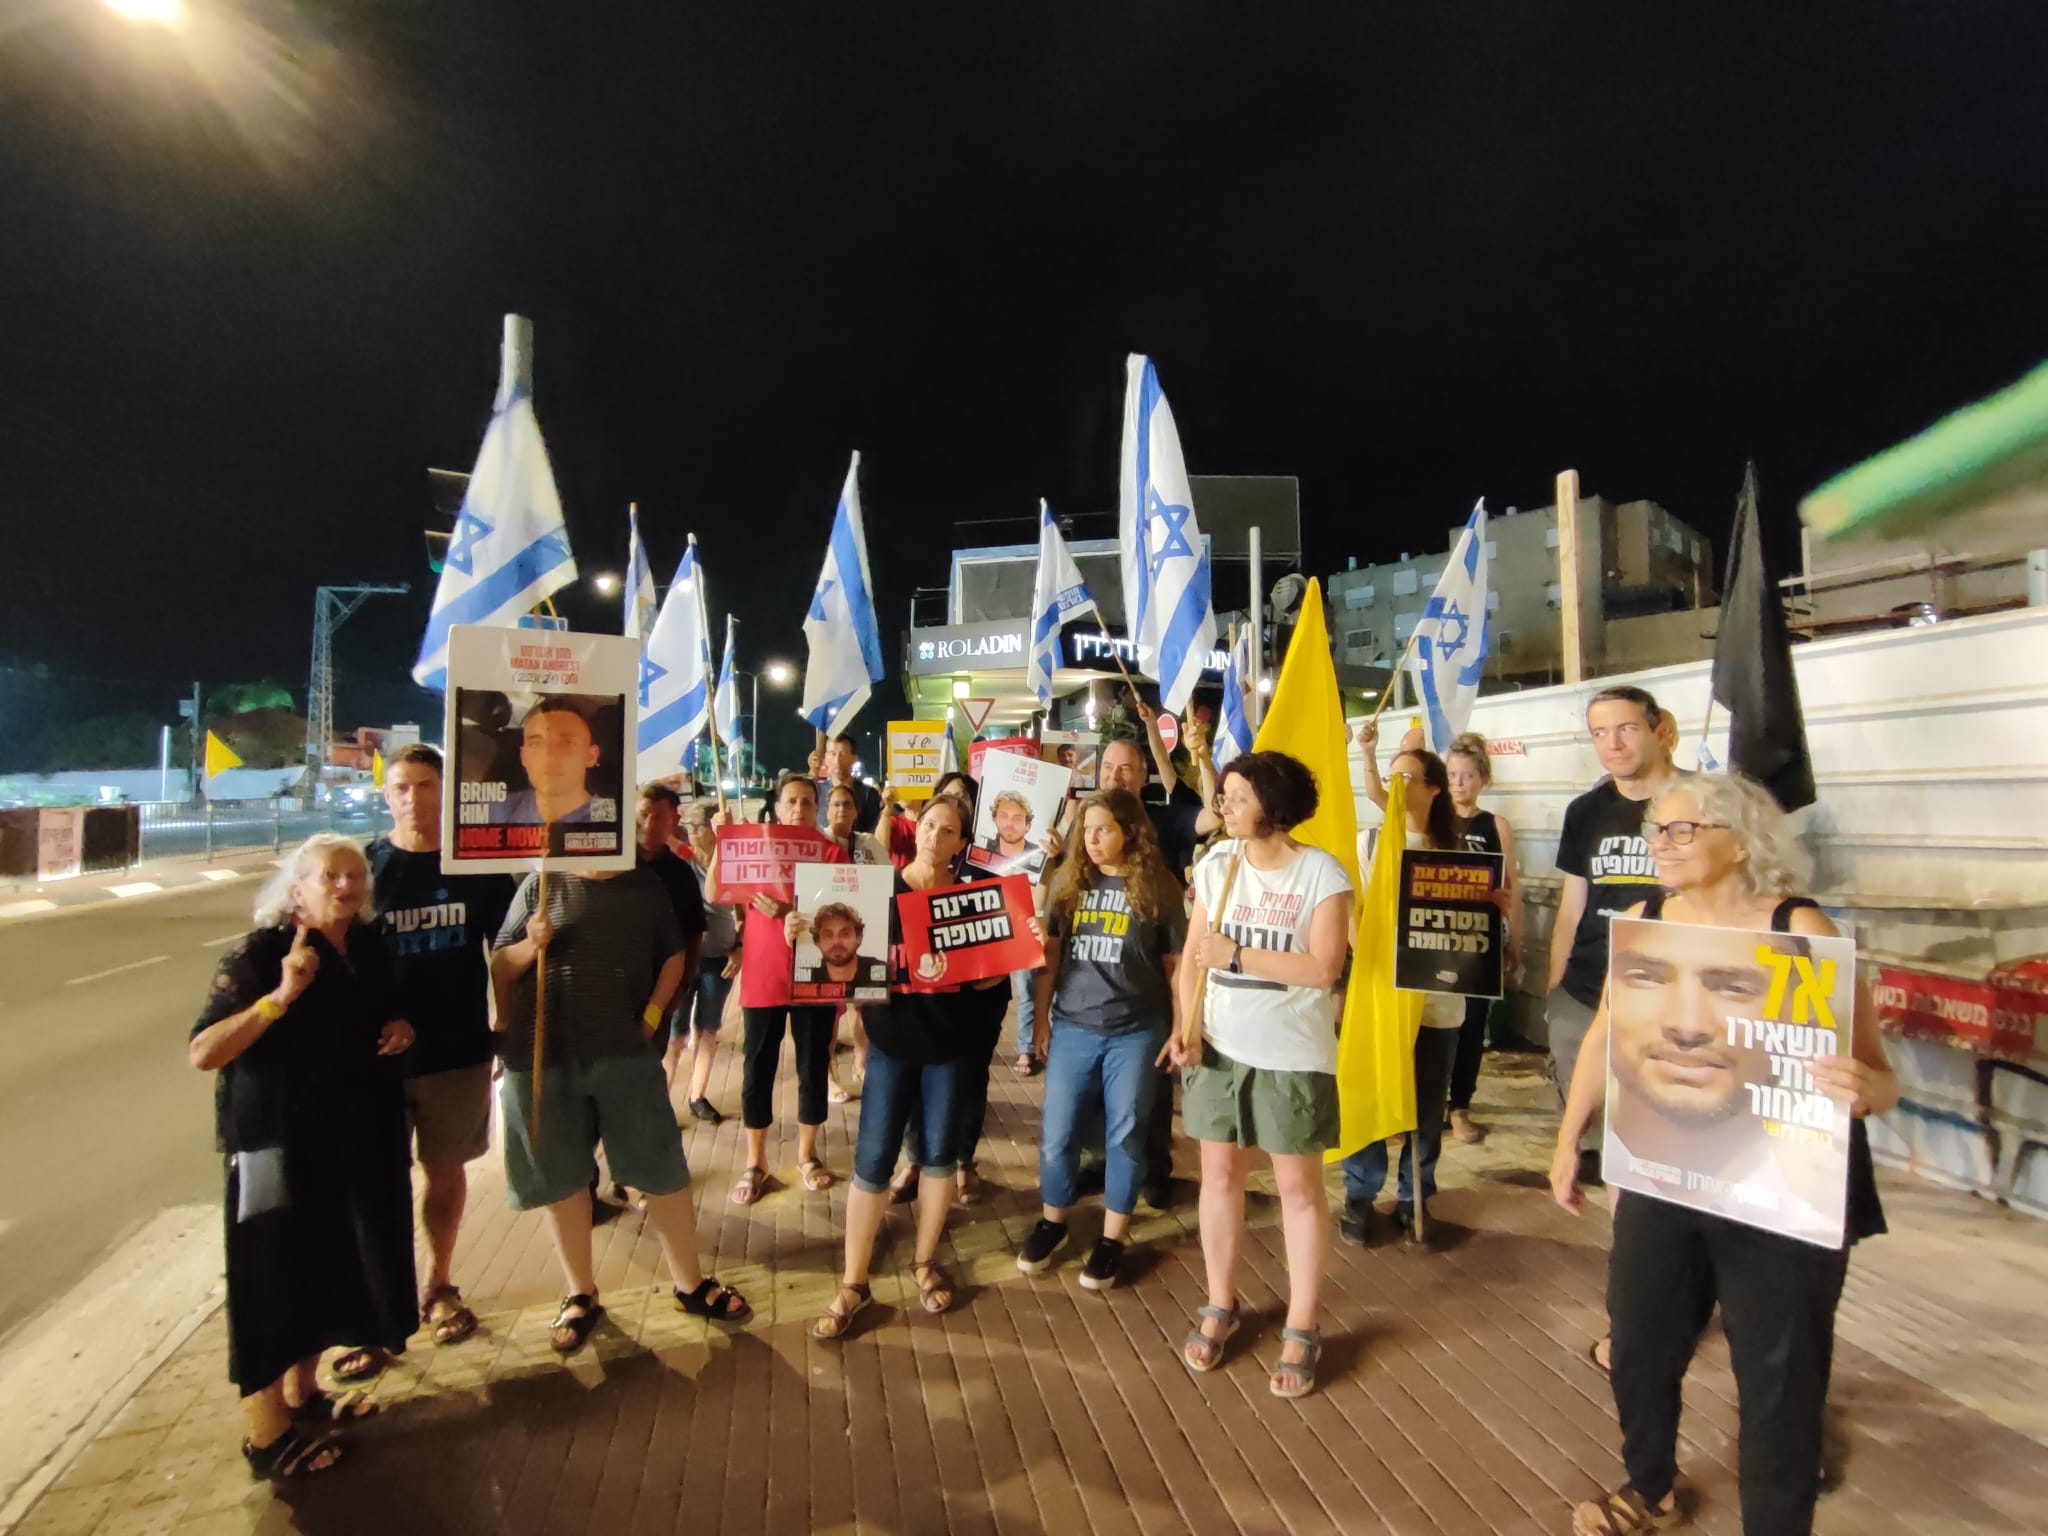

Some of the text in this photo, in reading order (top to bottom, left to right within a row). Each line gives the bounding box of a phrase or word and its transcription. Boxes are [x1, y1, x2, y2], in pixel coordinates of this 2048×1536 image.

[937, 633, 1022, 659] ROLADIN
[913, 754, 924, 769] בן
[908, 774, 932, 783] בעזה
[460, 782, 507, 803] BRING
[460, 803, 490, 825] HIM
[459, 826, 501, 848] HOME
[798, 842, 819, 858] עד
[1413, 865, 1490, 884] מצילים את
[932, 889, 1001, 920] מדינה
[1101, 889, 1132, 913] מה
[384, 902, 466, 933] חופשי
[1071, 910, 1130, 936] עדיין
[1408, 907, 1489, 933] מסרבים
[933, 915, 1010, 949] חטופה
[1408, 931, 1489, 954] למלחמה
[1070, 934, 1124, 964] בעזה?
[1755, 944, 1838, 1029] אל
[1726, 1016, 1837, 1057] תשאירו
[1769, 1054, 1822, 1094] ותי
[1744, 1083, 1835, 1131] מאחור
